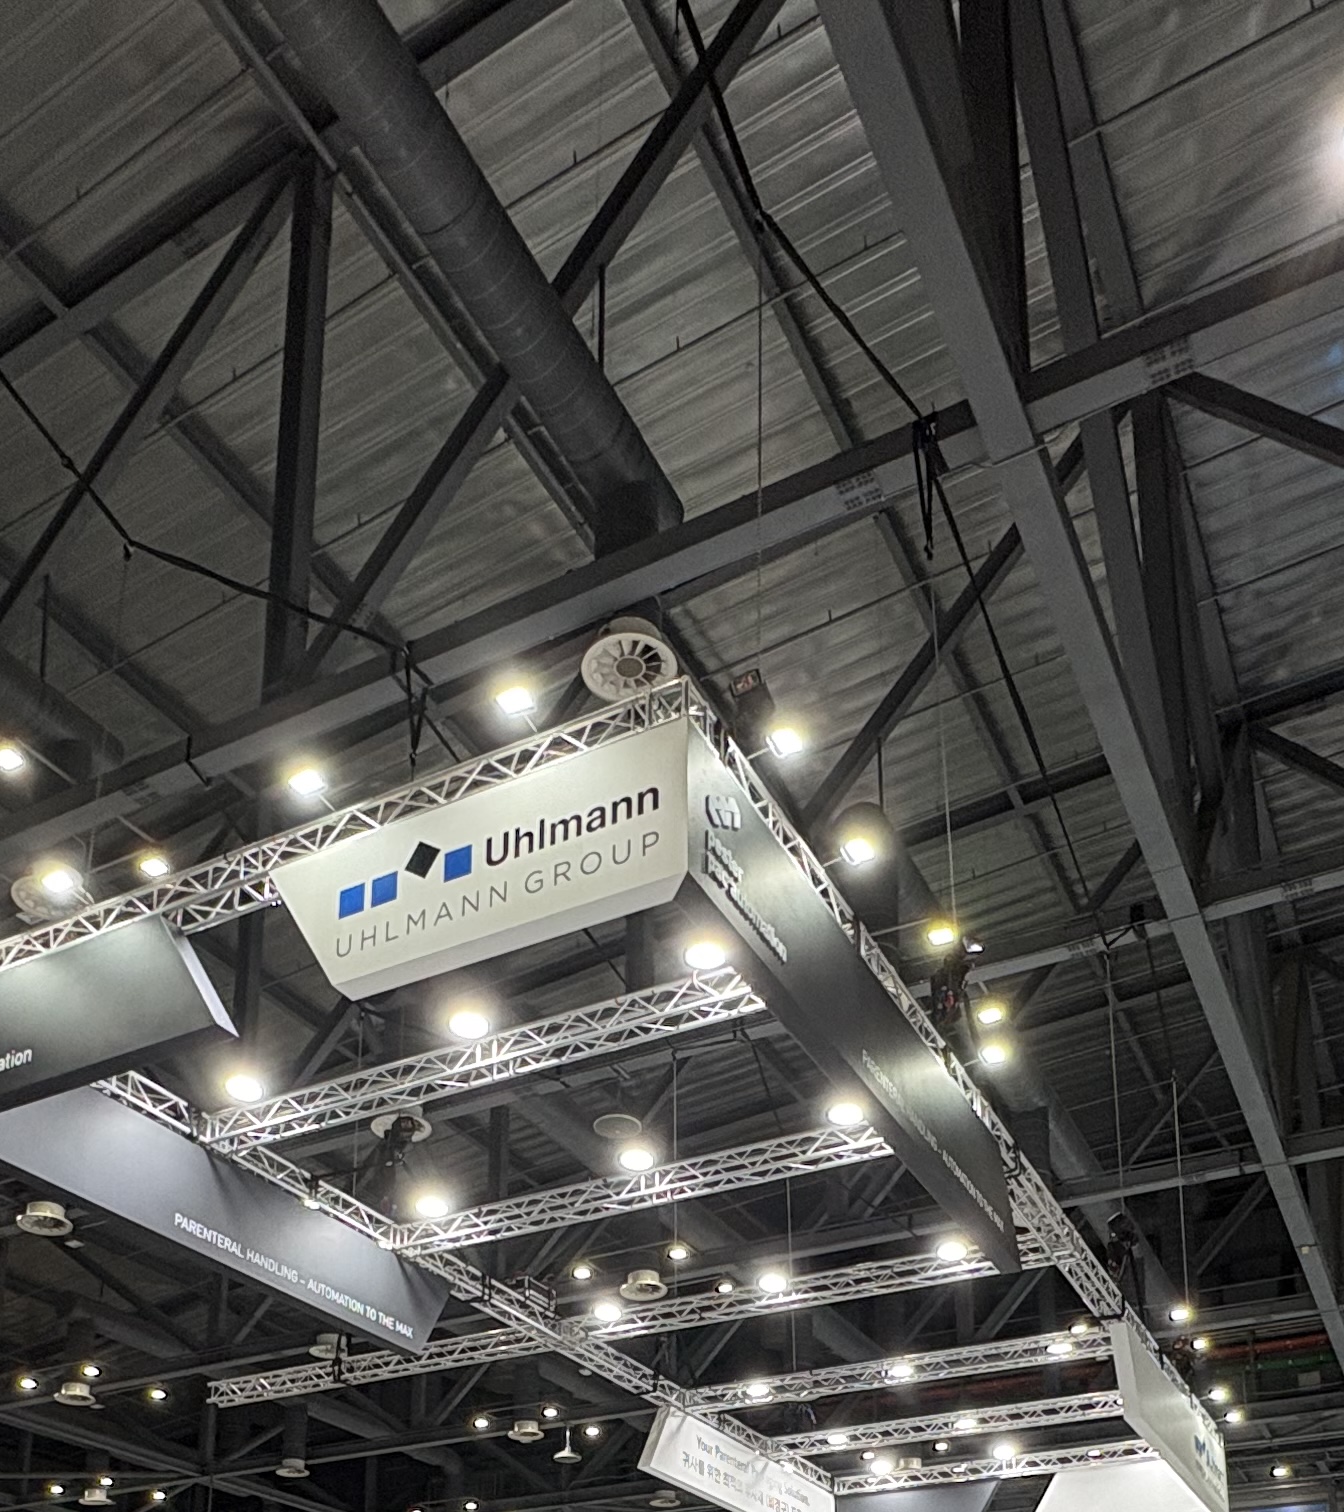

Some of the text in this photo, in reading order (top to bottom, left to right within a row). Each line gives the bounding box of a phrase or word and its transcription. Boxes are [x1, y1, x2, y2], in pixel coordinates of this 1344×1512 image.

[485, 786, 660, 867] Uhlmann
[336, 831, 660, 958] UHLMANN GROUP
[174, 1212, 245, 1259] PARENTERAL
[246, 1249, 299, 1284] HANDLING
[307, 1278, 364, 1315] AUTOMATION
[365, 1305, 377, 1320] TO
[377, 1310, 395, 1330] THE
[395, 1320, 413, 1339] MAX
